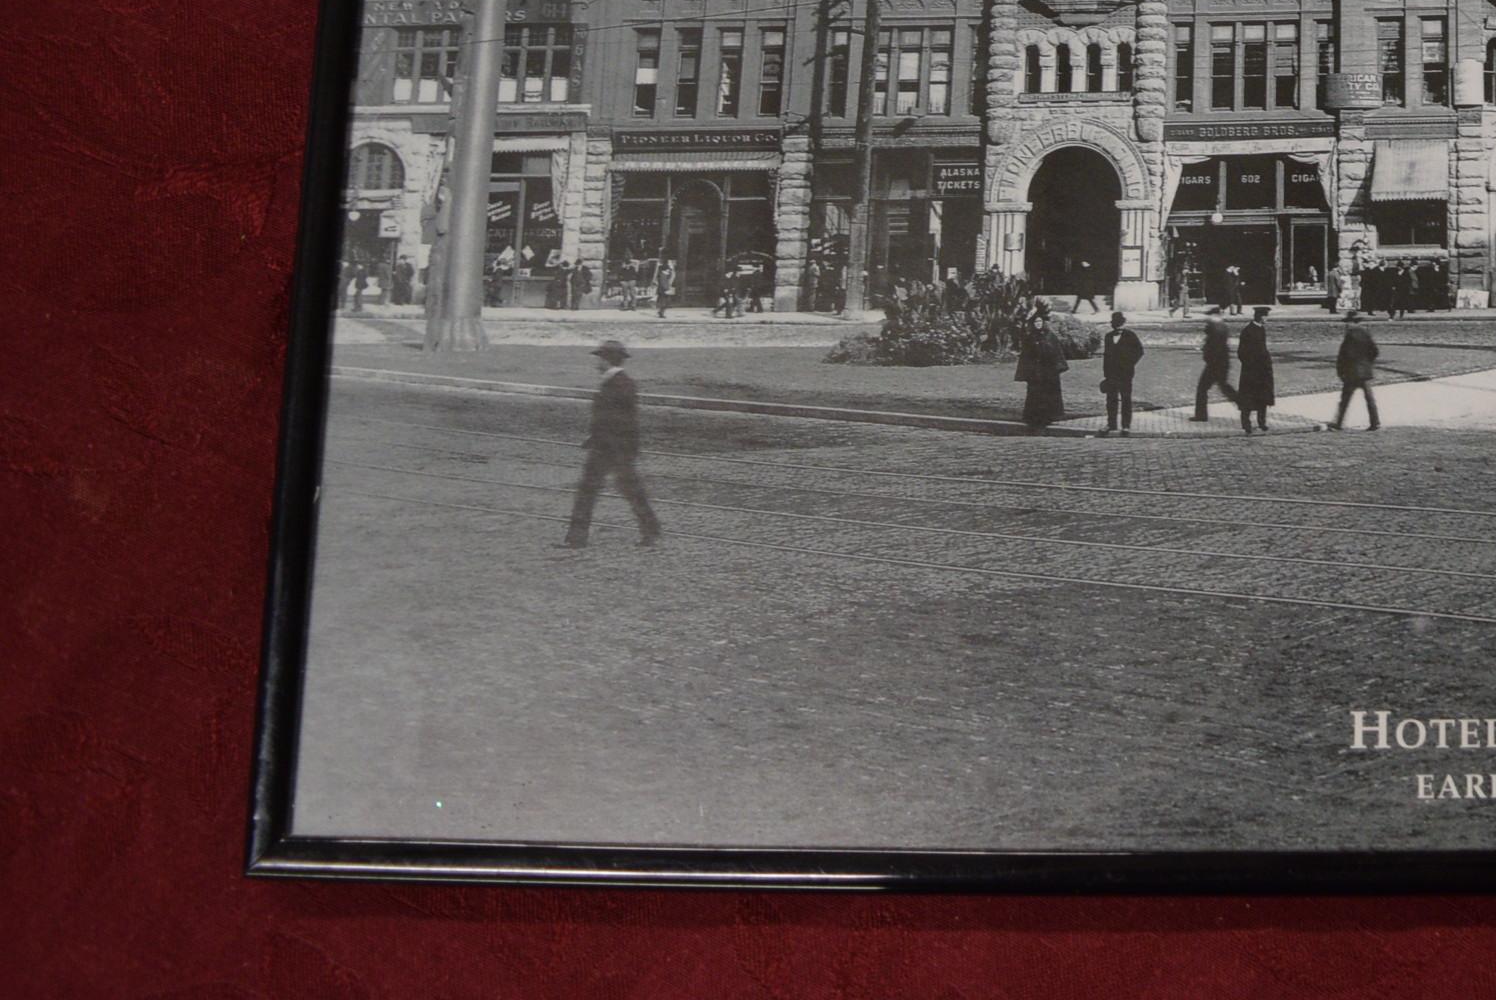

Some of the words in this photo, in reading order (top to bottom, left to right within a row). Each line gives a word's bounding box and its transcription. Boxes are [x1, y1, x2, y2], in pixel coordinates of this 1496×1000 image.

[1199, 126, 1259, 137] GOLDBERG
[621, 134, 690, 145] PIONEER
[693, 133, 751, 144] LIQUOR
[940, 167, 981, 177] ALASKA
[1180, 175, 1212, 185] IGARS
[1240, 174, 1262, 184] 602
[936, 180, 982, 190] TICKETS
